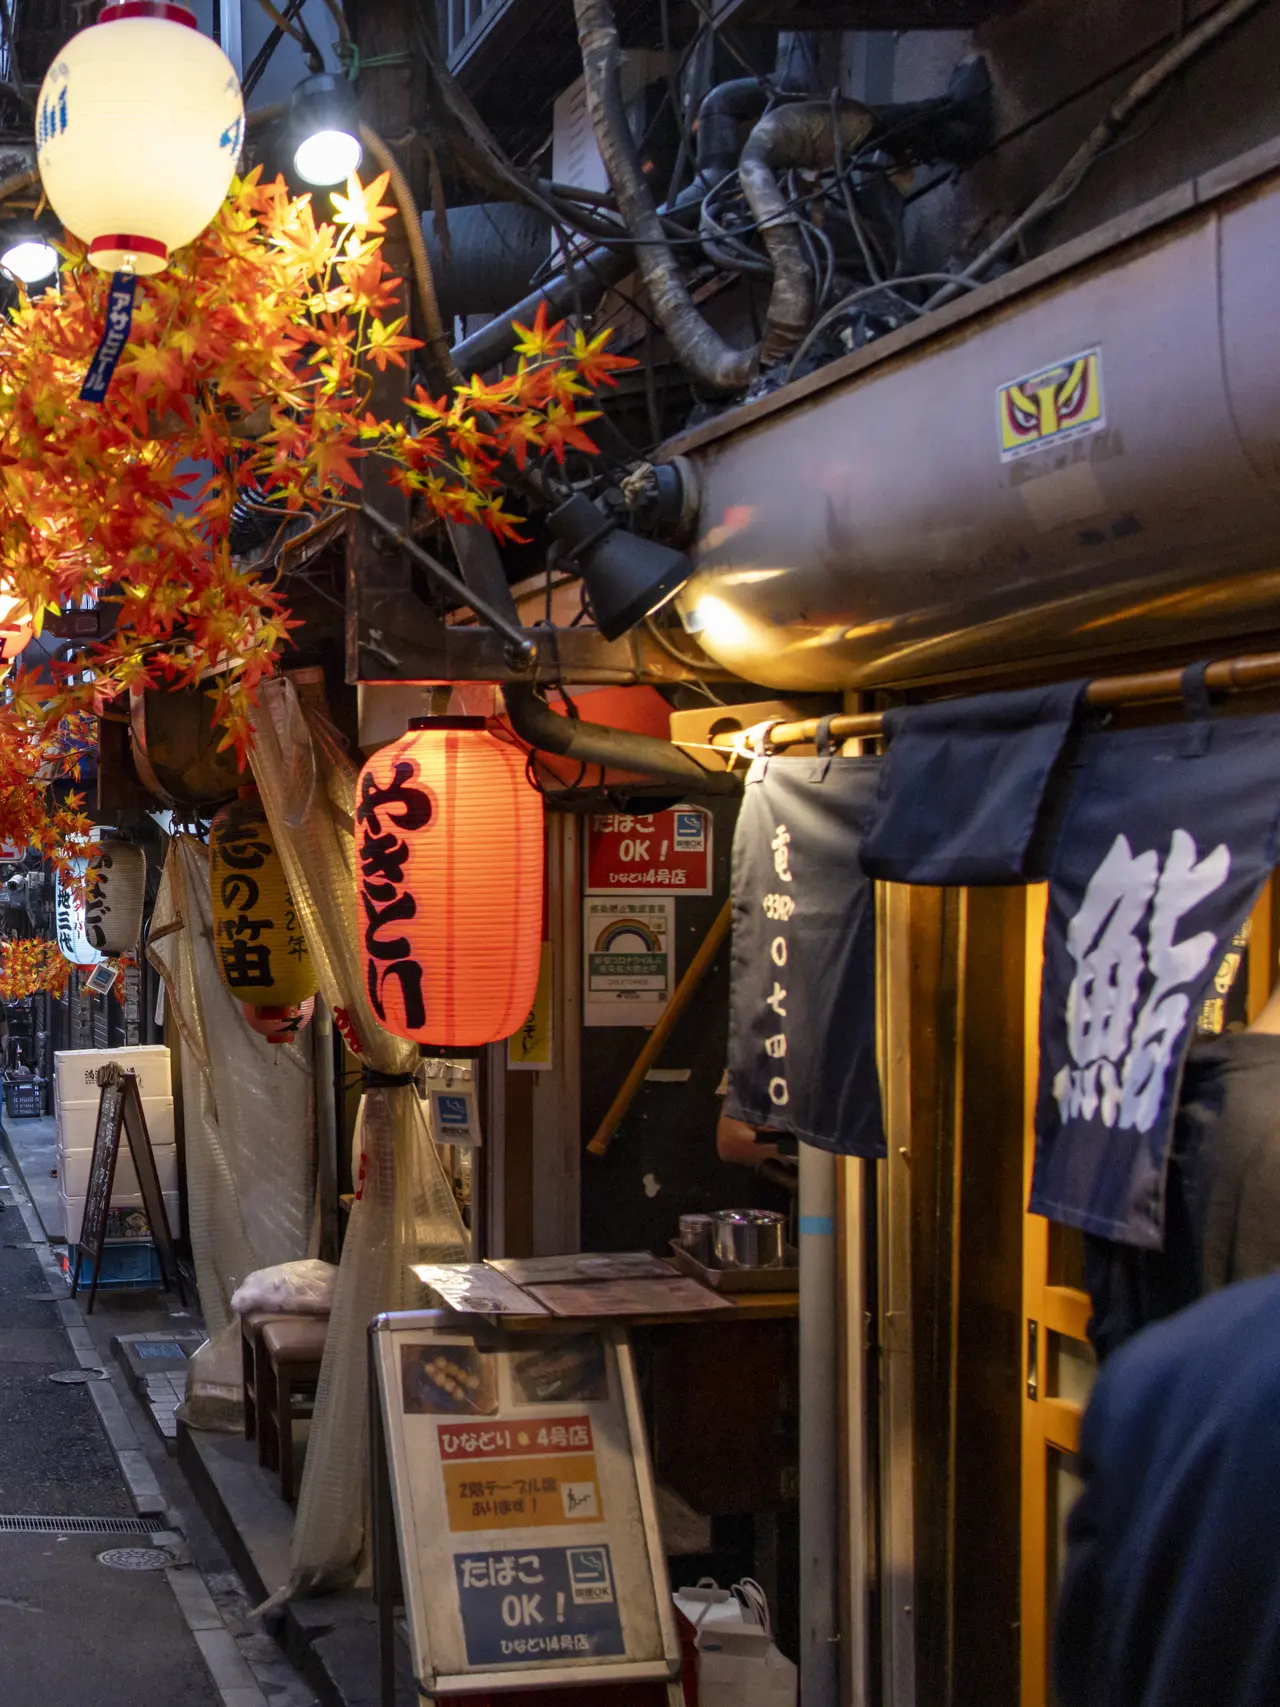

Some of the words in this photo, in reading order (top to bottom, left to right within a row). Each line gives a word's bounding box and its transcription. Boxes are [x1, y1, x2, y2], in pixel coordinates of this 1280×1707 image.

[608, 869, 686, 885] ひなどり4号店
[357, 761, 432, 1029] やきとり
[441, 1429, 511, 1453] ひなどり
[536, 1425, 589, 1447] 4号店
[460, 1554, 544, 1588] たばこ
[500, 1634, 590, 1654] ひなどり4号店
